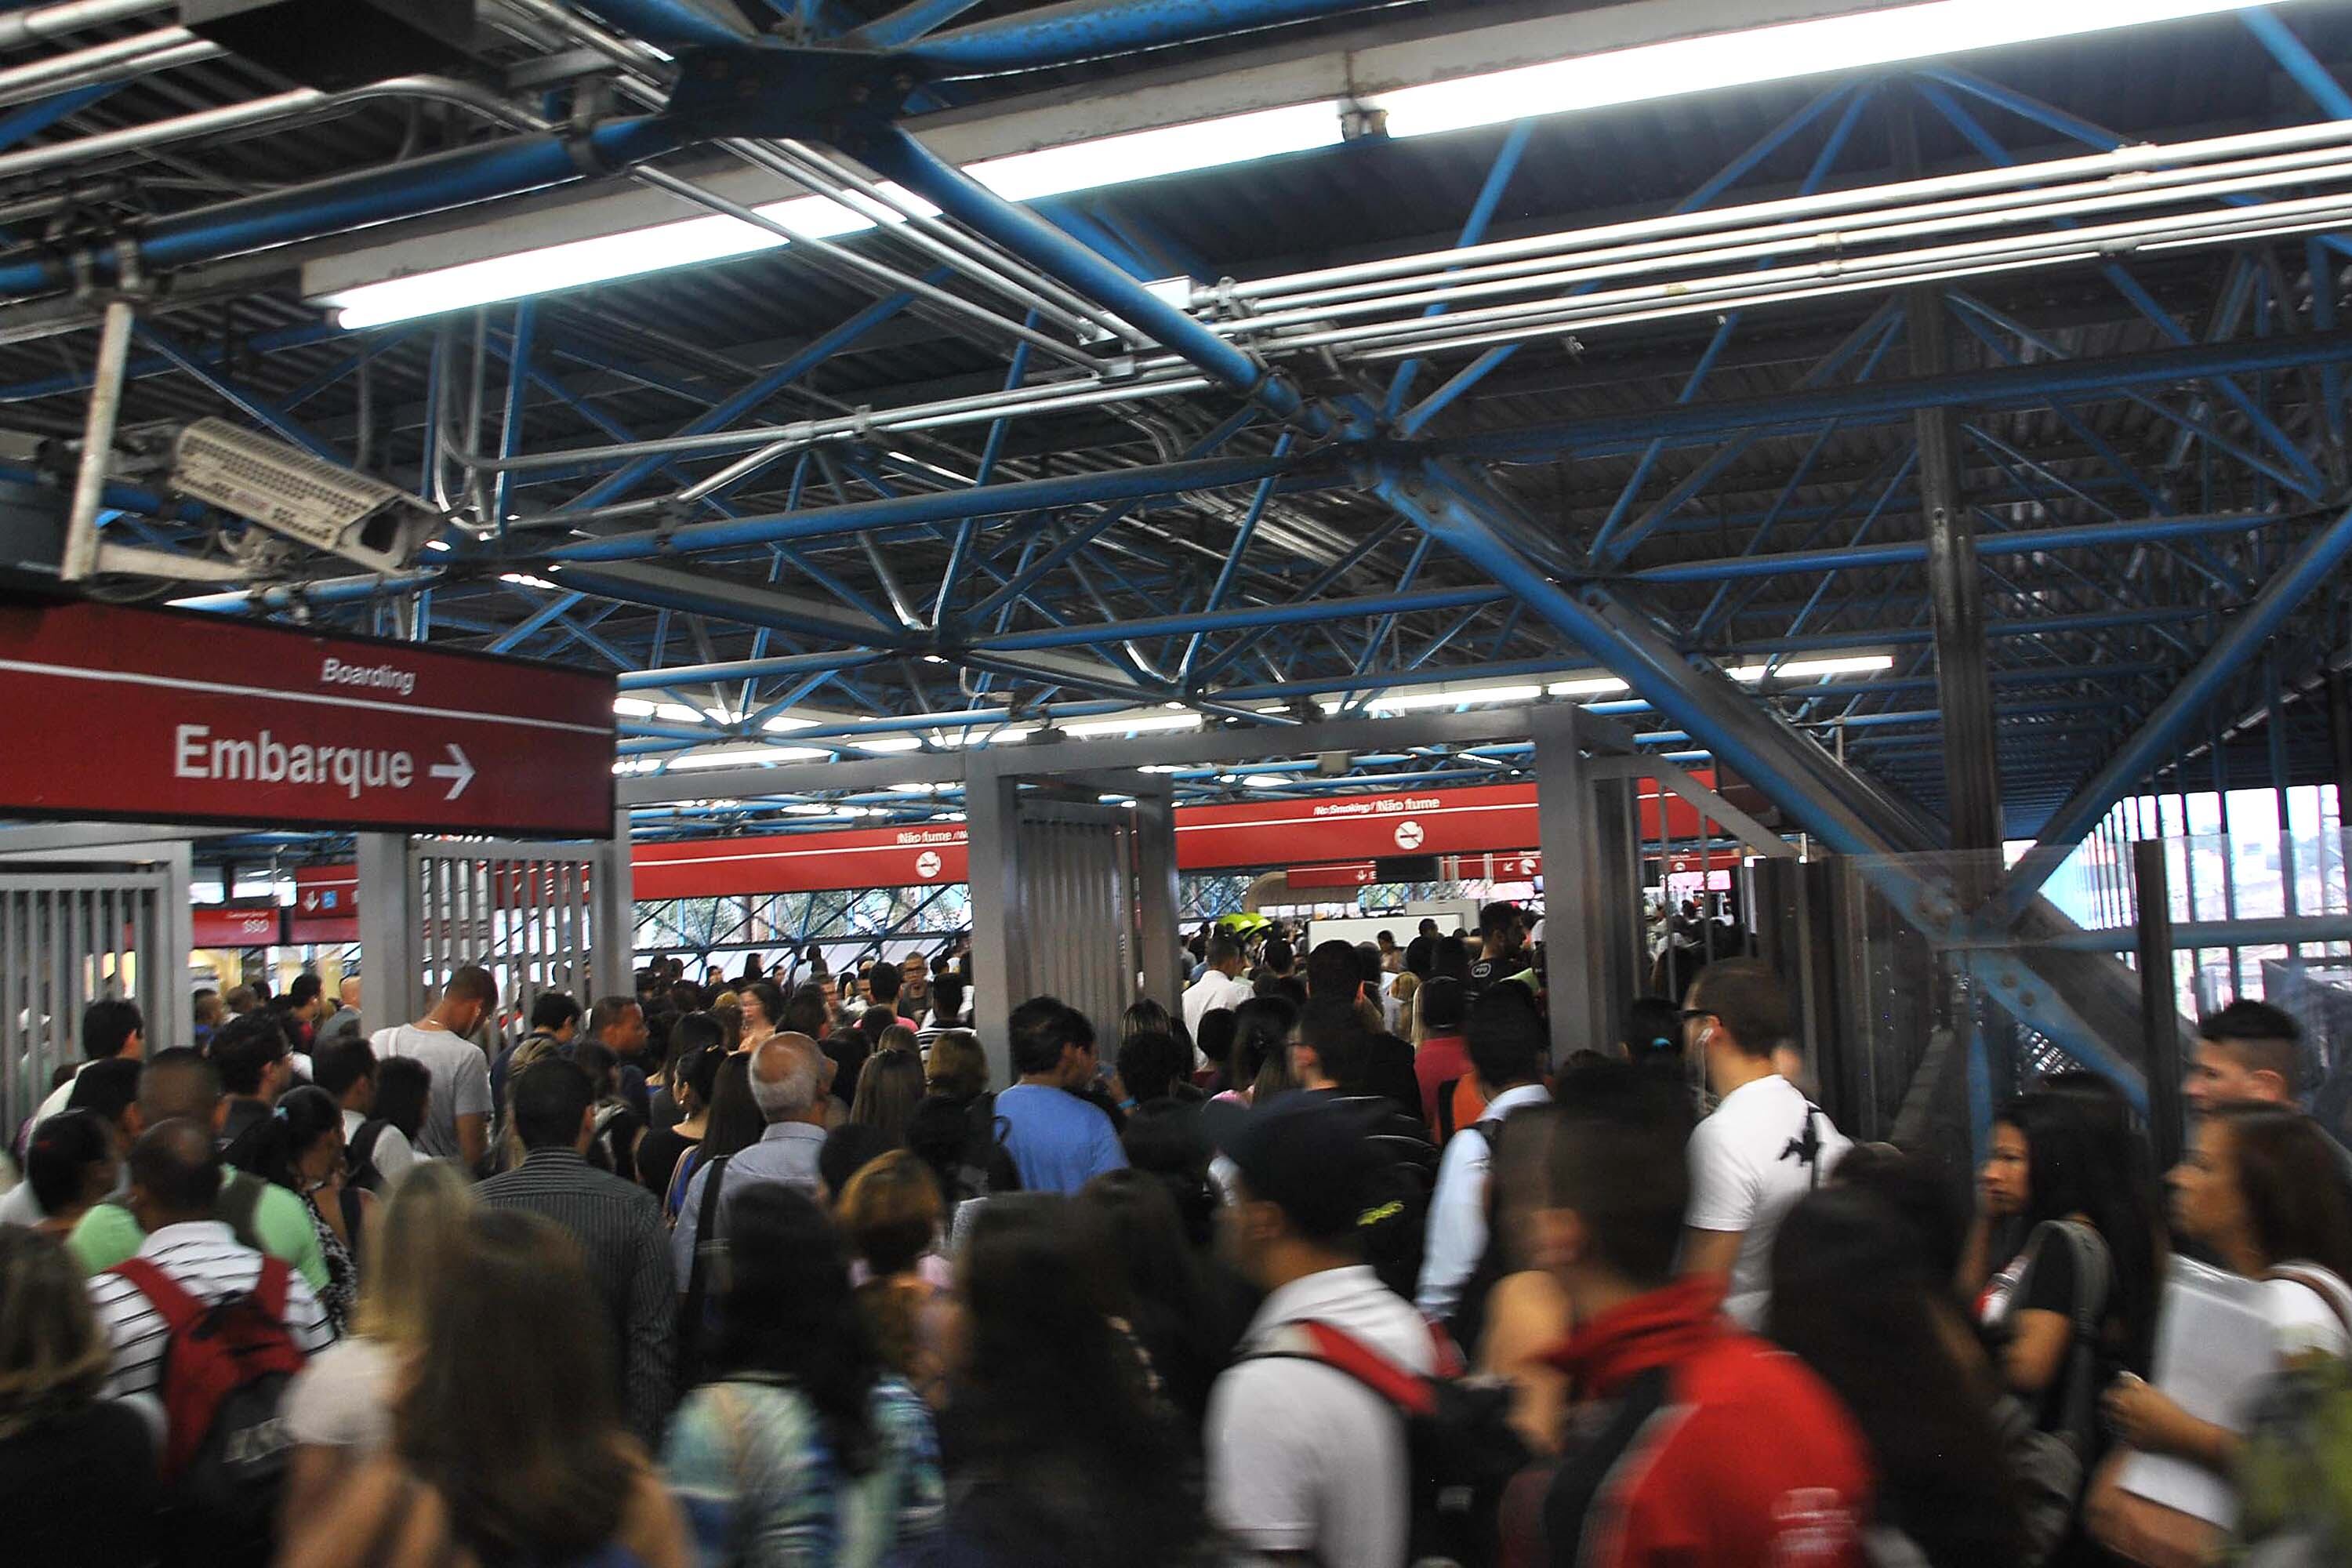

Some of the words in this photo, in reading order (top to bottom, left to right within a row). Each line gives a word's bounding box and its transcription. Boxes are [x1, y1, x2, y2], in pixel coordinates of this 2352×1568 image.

[321, 658, 416, 695] Boarding
[175, 724, 414, 799] Embarque
[1313, 805, 1329, 816] No
[1376, 799, 1403, 812] Não
[1404, 797, 1440, 811] fume
[897, 831, 921, 844] Não
[922, 830, 953, 843] fume
